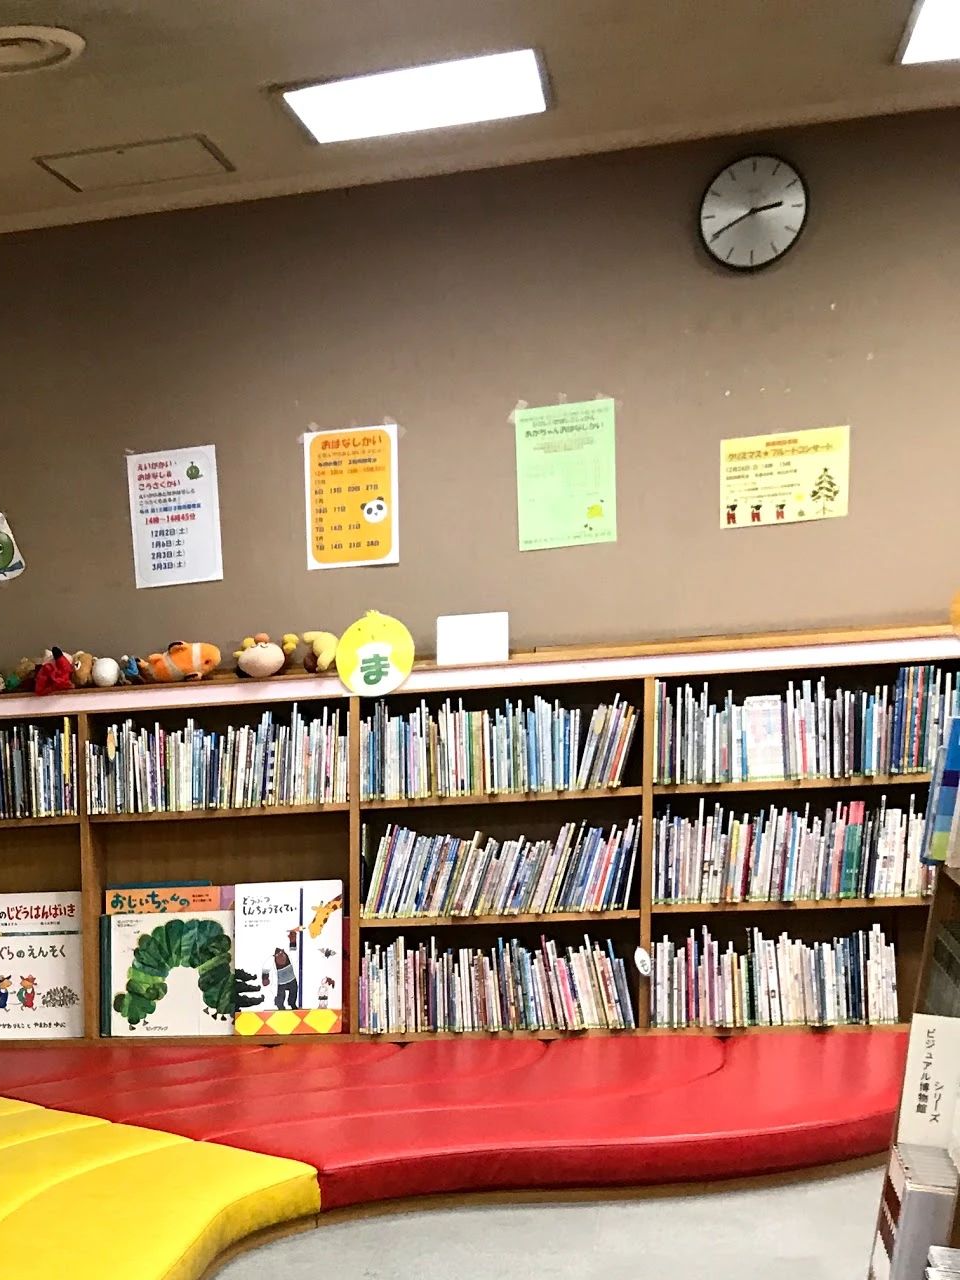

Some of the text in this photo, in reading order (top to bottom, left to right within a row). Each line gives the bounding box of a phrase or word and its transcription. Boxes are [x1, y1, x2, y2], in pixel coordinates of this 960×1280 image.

[321, 435, 382, 450] おはなしかい
[360, 653, 390, 685] ま
[111, 890, 190, 910] おじいちゃんの
[242, 904, 297, 916] しんちょうそくてい
[916, 1028, 936, 1114] ビジュアル博物館
[929, 1081, 944, 1123] シリーズ
